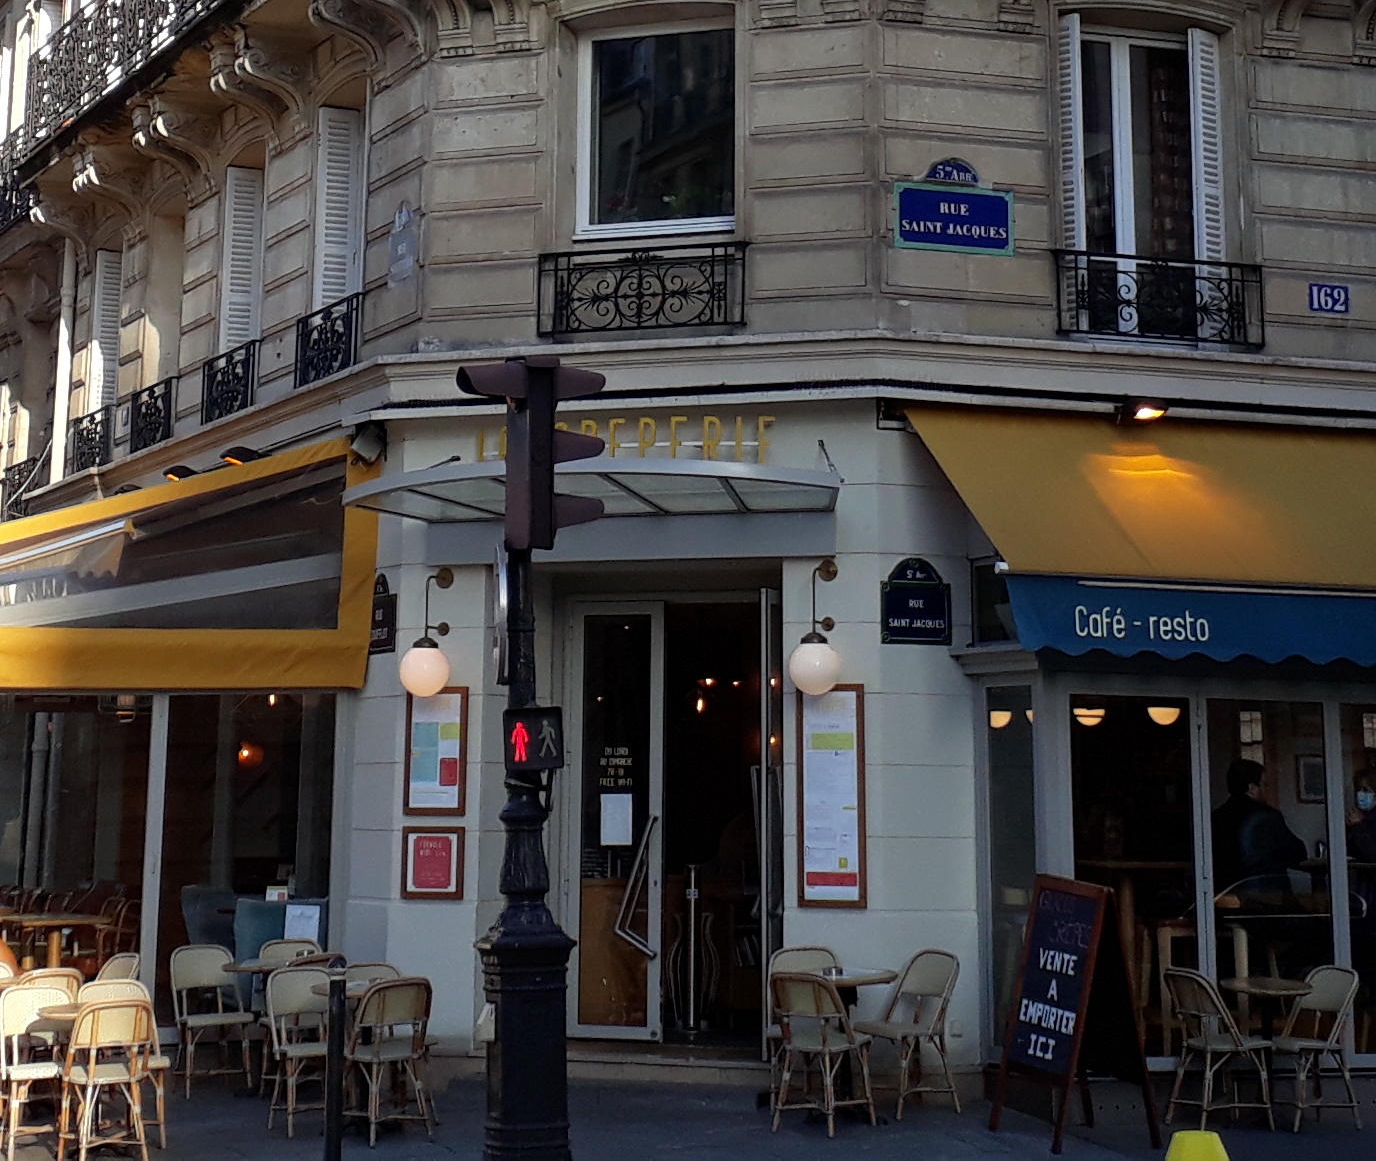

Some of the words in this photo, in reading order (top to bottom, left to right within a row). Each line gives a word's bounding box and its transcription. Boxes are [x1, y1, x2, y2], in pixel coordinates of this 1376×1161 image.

[939, 202, 970, 216] RUE
[901, 219, 943, 234] SAINT
[946, 223, 1007, 239] JACQUES
[1311, 286, 1346, 311] 162
[554, 415, 776, 464] EPERIE
[908, 599, 924, 609] RUE
[888, 618, 911, 628] SAINT
[911, 619, 945, 629] JACQUES
[1074, 605, 1126, 638] Café
[1148, 609, 1210, 641] resto
[1039, 947, 1078, 976] VENTE
[1047, 978, 1058, 1002] A
[1019, 998, 1077, 1036] EMPORTER
[1027, 1033, 1056, 1061] ICI
